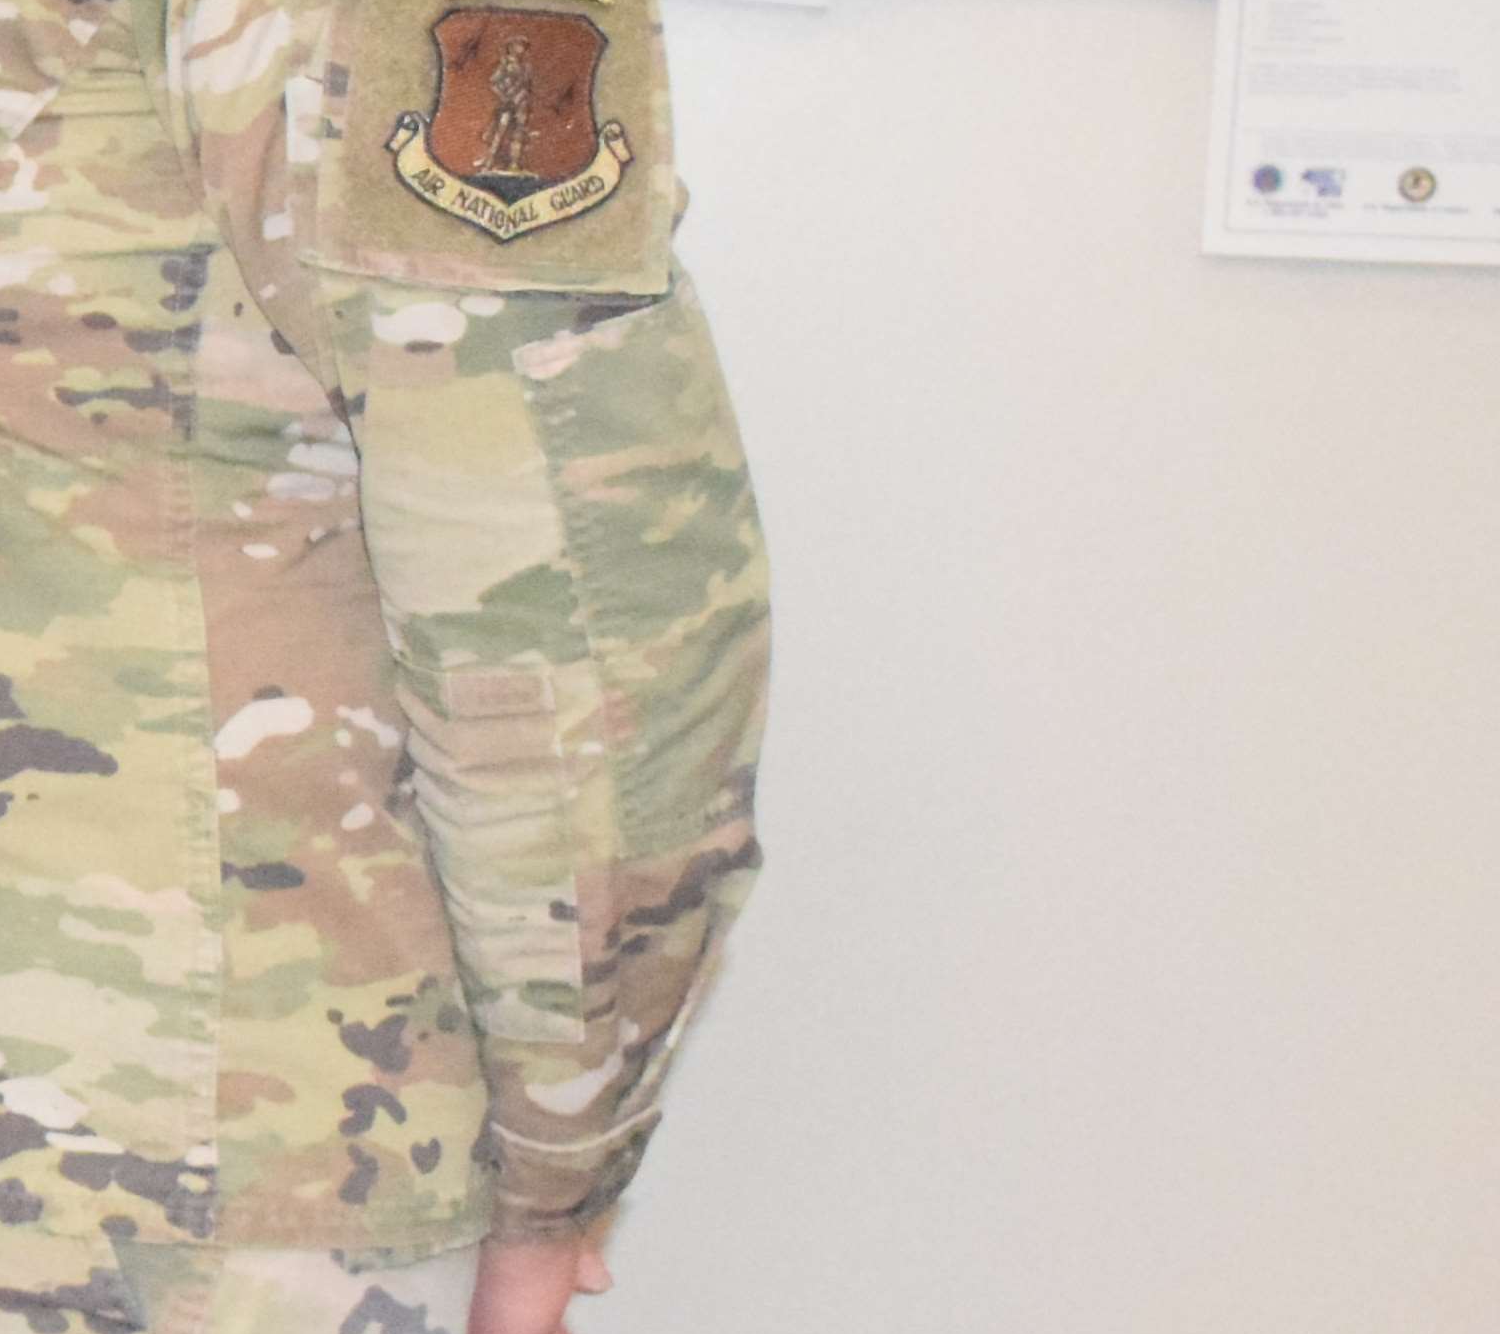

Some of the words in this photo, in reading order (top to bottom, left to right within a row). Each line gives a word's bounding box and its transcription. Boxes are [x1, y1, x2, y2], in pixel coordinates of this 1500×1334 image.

[411, 167, 446, 197] AIR
[451, 187, 543, 234] NATIONAL
[550, 175, 605, 212] GUARD
